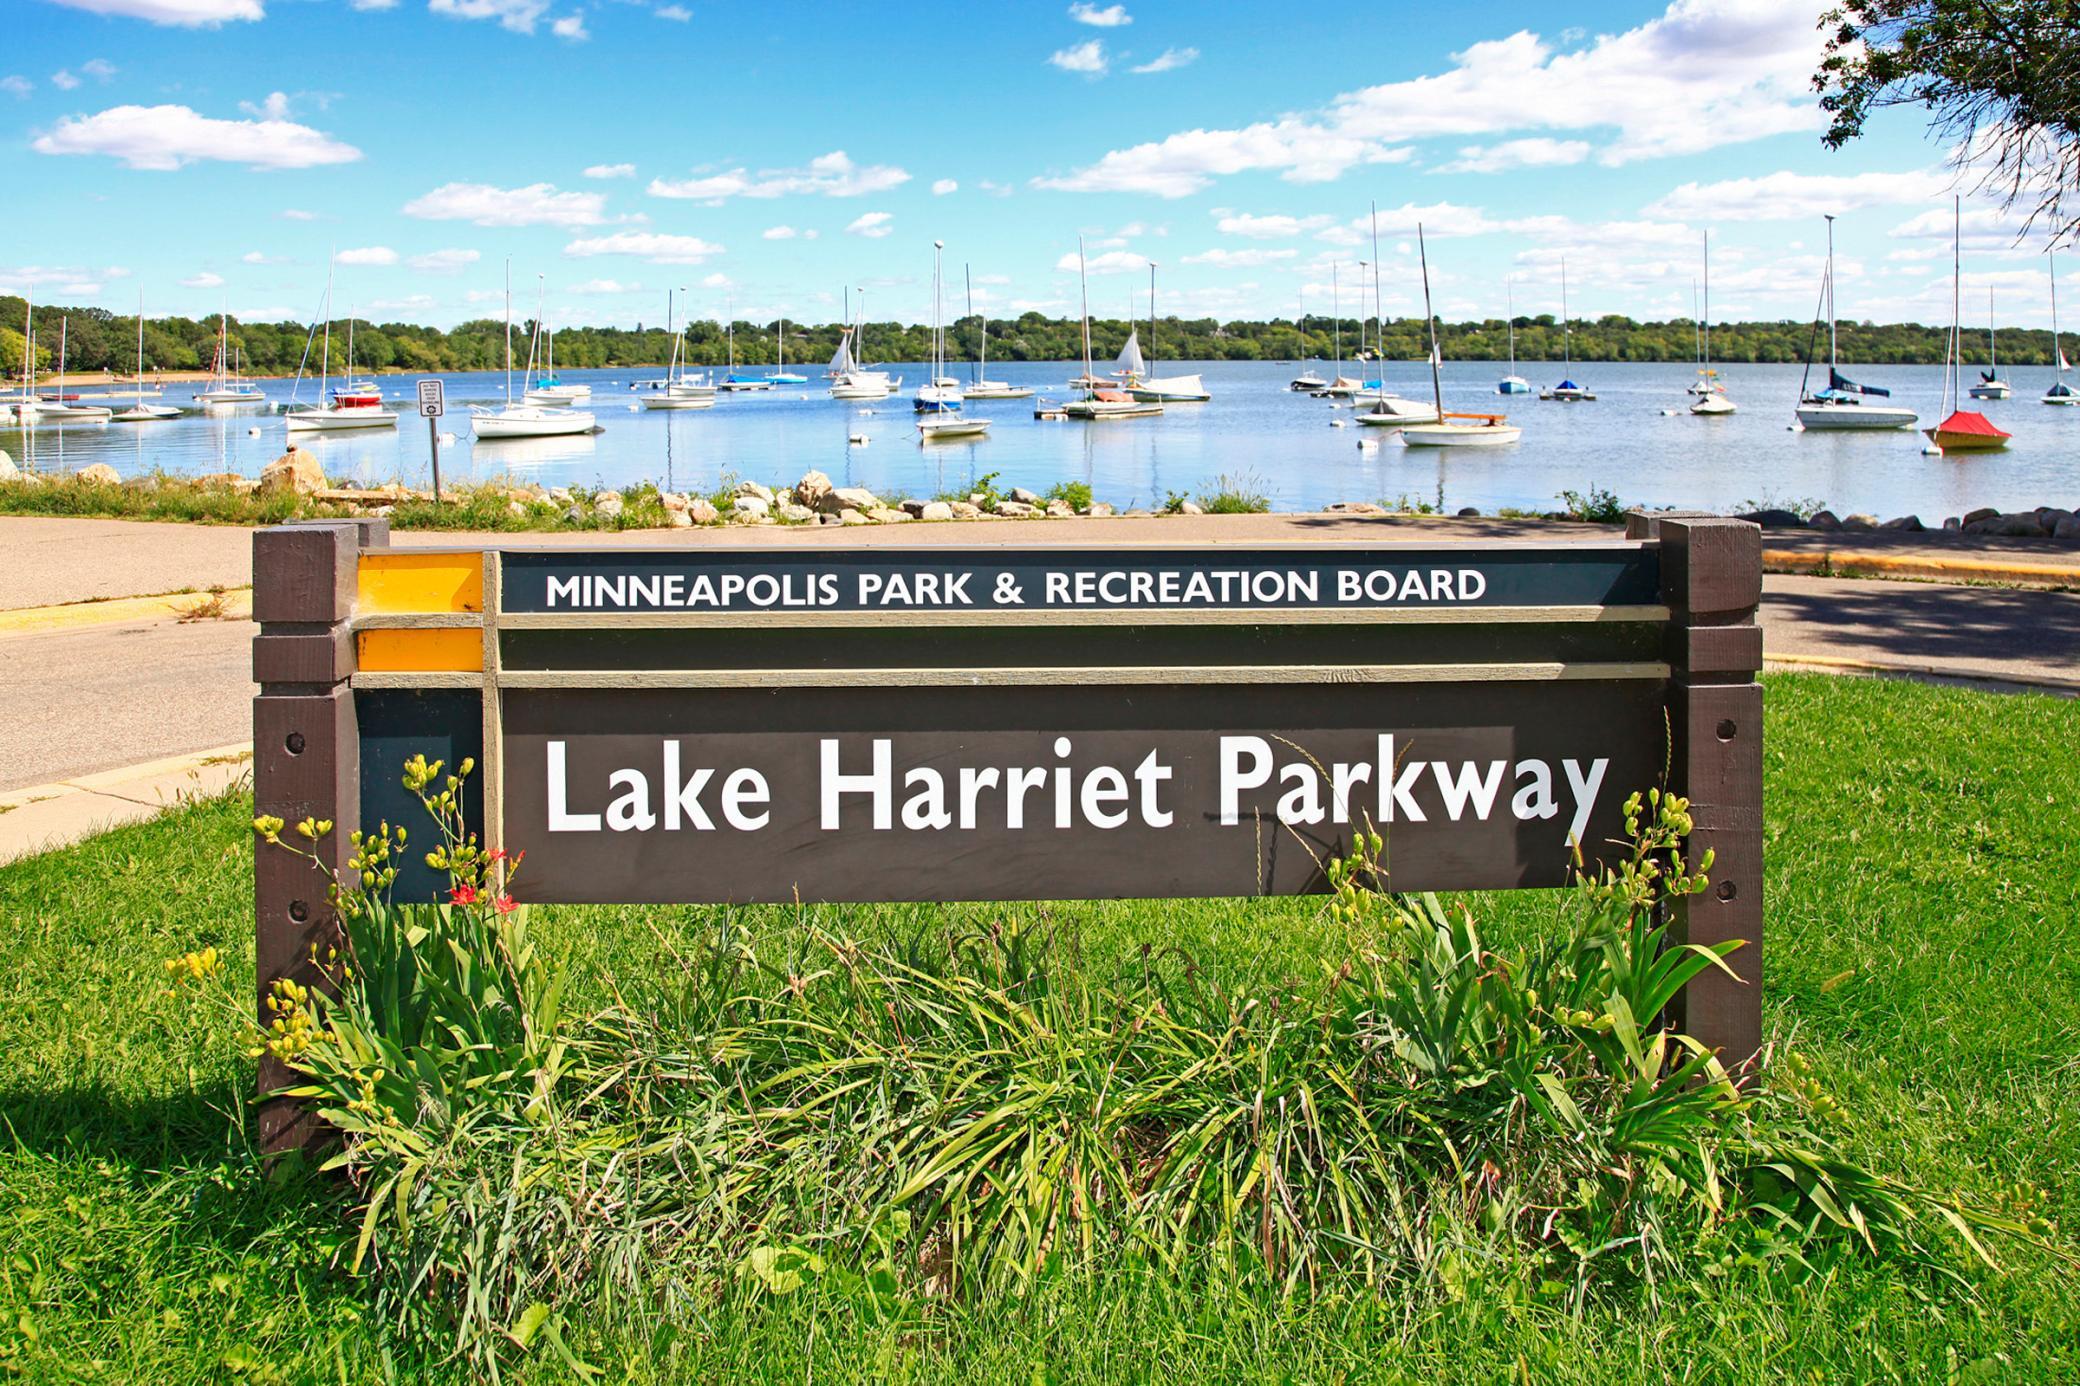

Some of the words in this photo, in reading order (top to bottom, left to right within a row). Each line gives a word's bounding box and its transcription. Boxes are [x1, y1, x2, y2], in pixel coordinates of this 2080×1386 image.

[547, 574, 839, 607] MINNEAPOLIS
[858, 573, 974, 605] PARK
[992, 572, 1025, 604] &
[1045, 570, 1318, 604] RECREATION
[1337, 569, 1486, 601] BOARD
[547, 739, 771, 832] Lake
[820, 736, 1174, 830] Harriet
[1219, 733, 1609, 847] Parkway
